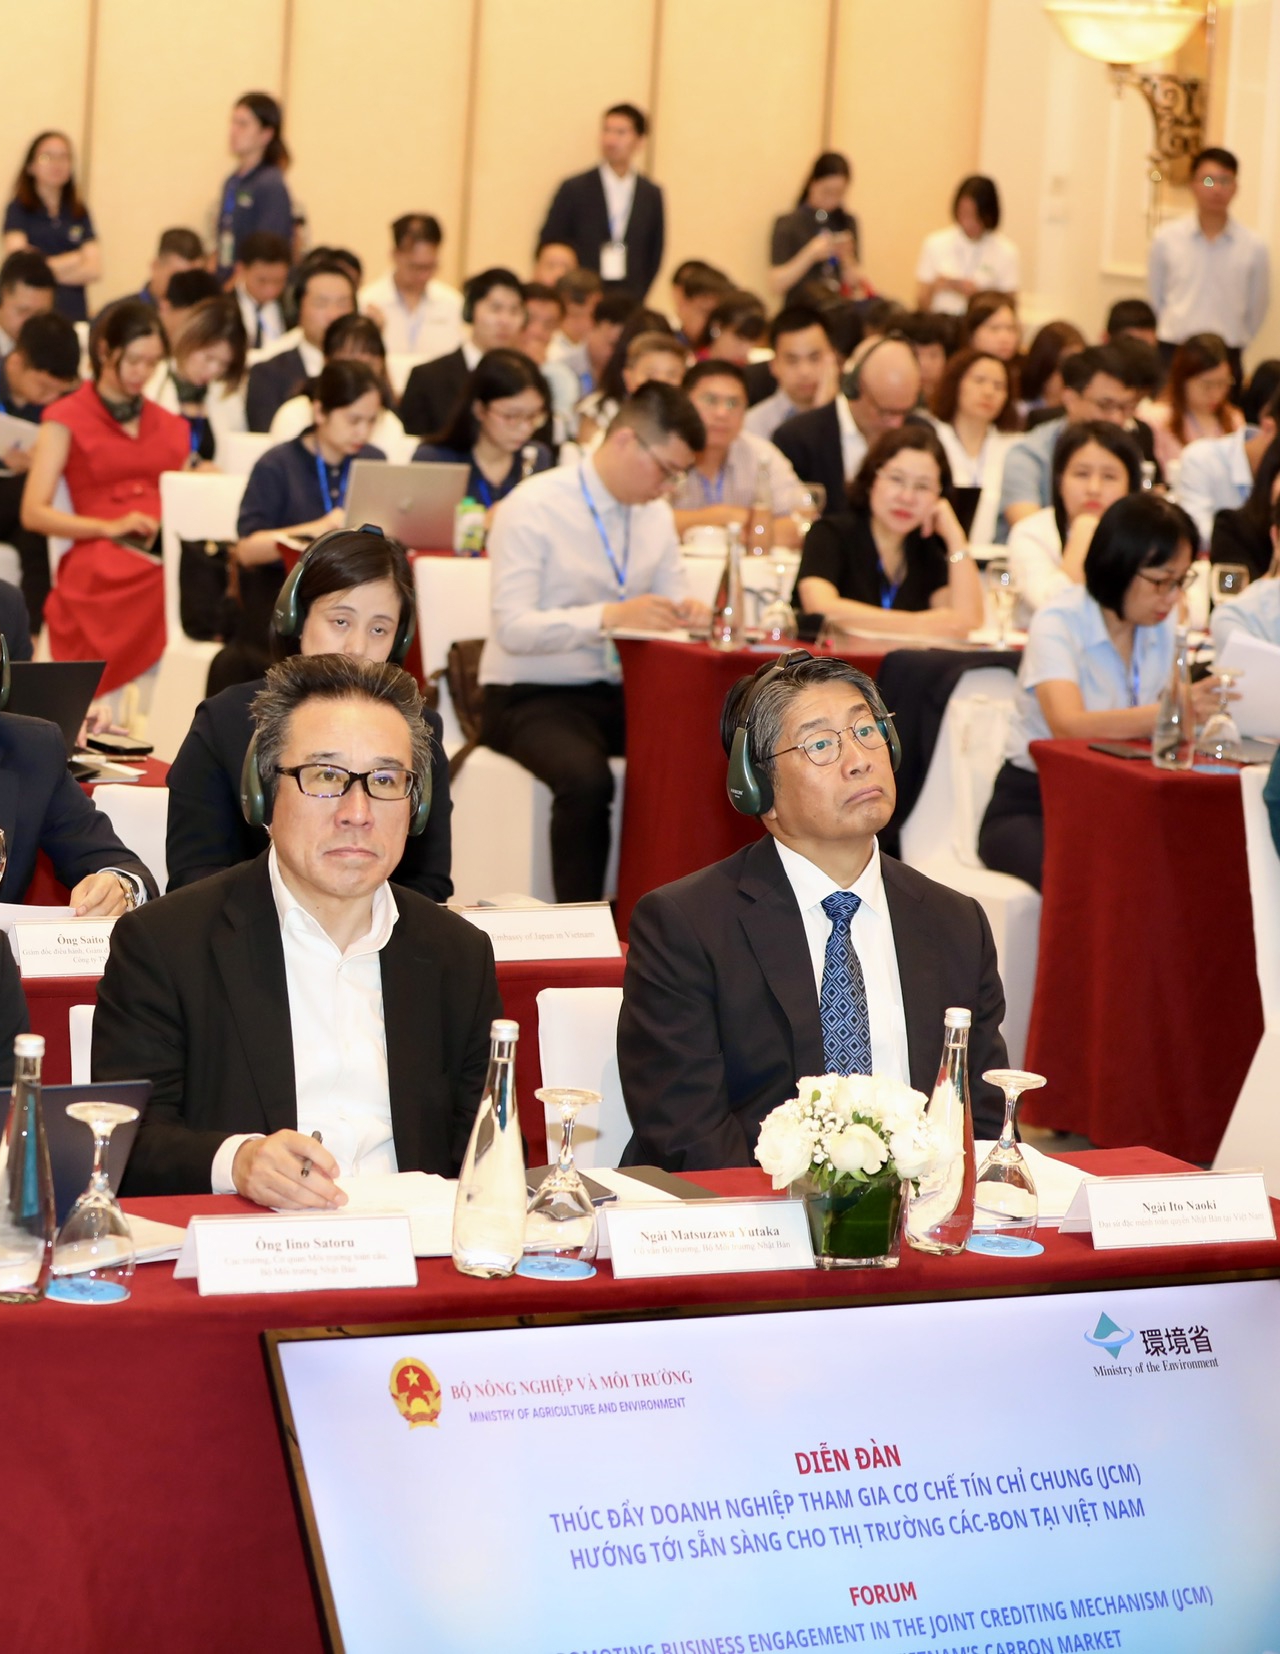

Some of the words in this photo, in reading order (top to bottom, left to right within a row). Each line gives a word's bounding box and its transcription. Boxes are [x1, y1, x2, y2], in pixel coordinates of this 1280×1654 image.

[58, 934, 78, 946] Ông
[80, 936, 104, 944] Saito
[492, 932, 524, 941] Embassy
[535, 932, 554, 941] Japan
[564, 931, 595, 939] Vietnam
[1142, 1202, 1166, 1214] Ngài
[1169, 1202, 1184, 1212] Ito
[1186, 1200, 1216, 1211] Naoki
[256, 1236, 282, 1252] Ông
[286, 1238, 310, 1250] Iino
[313, 1237, 354, 1248] Satoru
[640, 1230, 668, 1244] Ngài
[670, 1228, 735, 1241] Matsuzawa
[738, 1226, 780, 1238] Yutaka
[1140, 1326, 1212, 1356] 環境省
[1093, 1365, 1133, 1377] Ministry
[1135, 1360, 1144, 1374] of
[1146, 1361, 1160, 1372] the
[1162, 1357, 1219, 1371] Environment
[450, 1382, 471, 1402] BỘ
[474, 1378, 516, 1398] NÔNG
[520, 1374, 573, 1398] NGHIỆP
[578, 1372, 598, 1392] VÀ
[600, 1372, 629, 1391] MÔI
[633, 1368, 692, 1388] TRƯỜNG
[469, 1410, 515, 1422] MINISTRY
[518, 1408, 530, 1420] OF
[532, 1404, 596, 1418] AGRICULTURE
[598, 1402, 618, 1414] AND
[619, 1398, 686, 1413] ENVIRONMENT
[794, 1442, 850, 1475] DIỄN
[854, 1438, 901, 1469] ĐÀN
[549, 1505, 604, 1533] THÚC
[607, 1498, 645, 1528] ĐẨY
[650, 1500, 722, 1525] DOANH
[725, 1490, 794, 1520] NGHIỆP
[798, 1488, 854, 1512] THAM
[858, 1486, 890, 1507] GIA
[893, 1481, 920, 1503] CƠ
[923, 1473, 959, 1500] CHẾ
[960, 1472, 992, 1497] TÍN
[996, 1467, 1026, 1494] CHỈ
[1030, 1467, 1093, 1491] CHUNG
[1096, 1463, 1142, 1490] (JCM)
[570, 1540, 646, 1570] HƯỚNG
[649, 1535, 684, 1562] TỚI
[688, 1530, 726, 1559] SẴN
[730, 1529, 782, 1554] SÀNG
[786, 1528, 826, 1549] CHO
[829, 1525, 863, 1548] THỊ
[864, 1514, 944, 1542] TRƯỜNG
[948, 1509, 1028, 1534] CÁC-BON
[1030, 1506, 1060, 1530] TẠI
[1064, 1498, 1099, 1527] VIỆT
[1103, 1498, 1146, 1522] NAM
[848, 1581, 917, 1606] FORUM
[660, 1636, 745, 1654] BUSINESS
[748, 1623, 866, 1652] ENGAGEMENT
[870, 1620, 890, 1640] IN
[892, 1616, 926, 1638] THE
[929, 1611, 976, 1639] JOINT
[980, 1601, 1068, 1629] CREDITING
[1070, 1590, 1169, 1618] MECHANISM
[1172, 1585, 1214, 1612] (JCM)
[1056, 1630, 1122, 1654] MARKET
